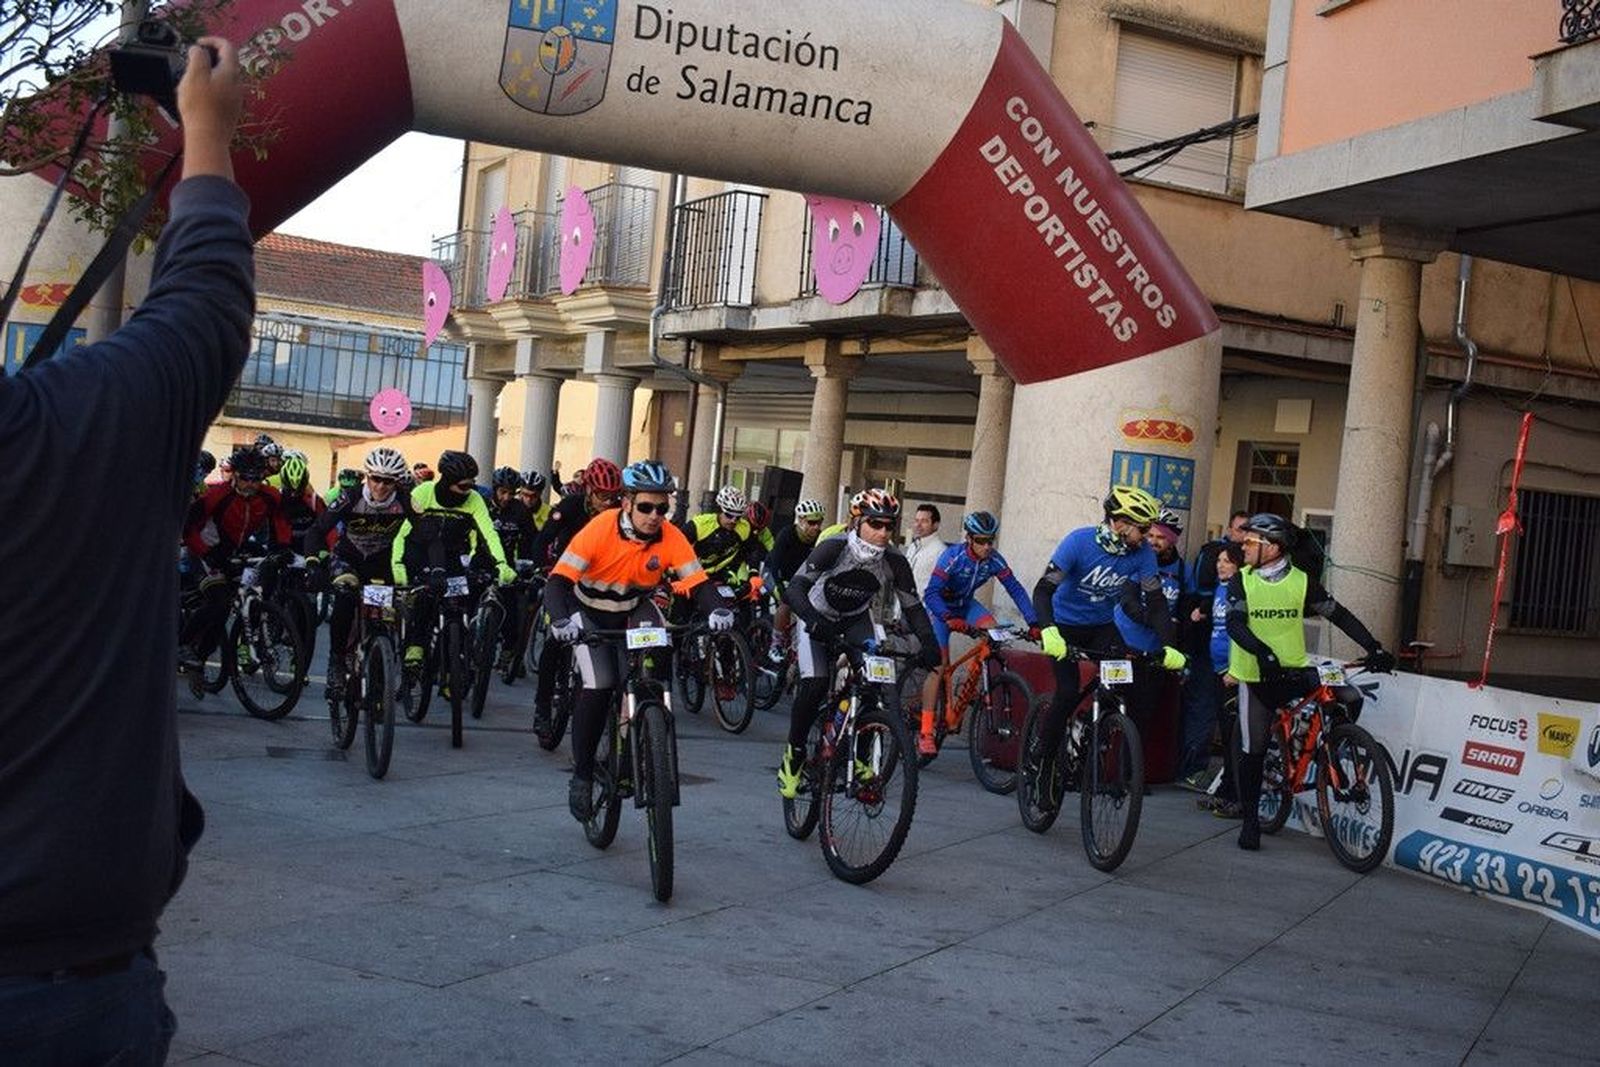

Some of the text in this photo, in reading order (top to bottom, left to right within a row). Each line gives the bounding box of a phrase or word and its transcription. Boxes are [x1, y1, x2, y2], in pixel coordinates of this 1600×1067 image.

[633, 4, 840, 71] Diputación
[626, 64, 873, 126] de Salamanca
[979, 135, 1139, 342] DEPORTISTAS
[1005, 96, 1177, 329] CON NUESTROS
[1469, 714, 1518, 735] FOCUS
[1466, 748, 1518, 768] SRAM
[1456, 781, 1513, 802] TIME
[1517, 801, 1569, 822] ORBEA
[1418, 839, 1600, 926] 923 33 22 13
